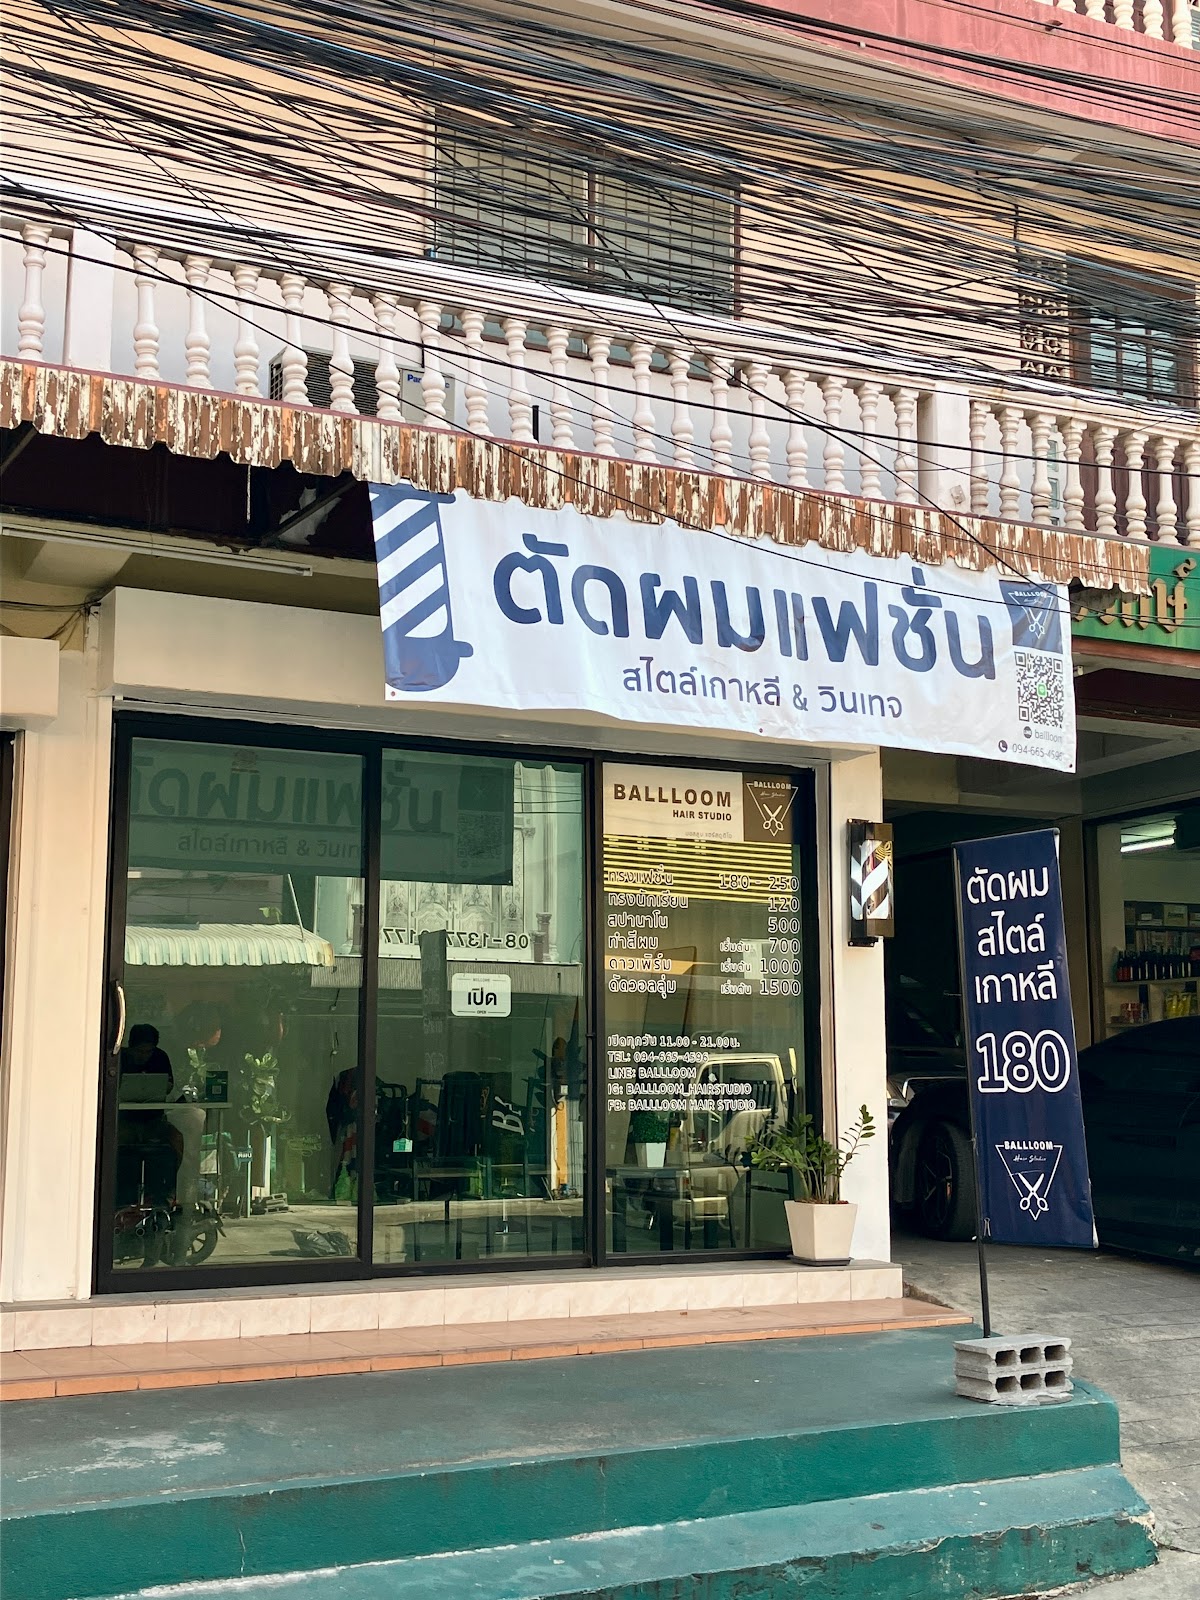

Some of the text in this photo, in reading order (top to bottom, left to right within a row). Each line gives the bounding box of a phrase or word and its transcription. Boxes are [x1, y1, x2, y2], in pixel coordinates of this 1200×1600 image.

[493, 532, 996, 680] ตัดผมแฟชั่น
[622, 656, 904, 719] สไตล์เกาหลี & วินเทจ
[613, 783, 731, 807] BALLLOOM
[753, 780, 792, 790] BALLLOOM
[672, 809, 732, 821] HAIR STUDIO
[607, 864, 674, 885] ทรงแฟชั่น
[719, 874, 751, 890] 180
[768, 876, 800, 892] 250
[967, 866, 1050, 904] ตัดผม
[608, 889, 800, 912] ทรงนักเรียน 120
[607, 910, 800, 933] สปานาโน 500
[608, 930, 800, 954] ทำสีผม เริ่มต้น 700
[977, 910, 1045, 957] สไตล์
[609, 953, 801, 975] ดาวเพิร์ม เริ่มต้น 1000
[609, 974, 801, 999] ดัดวอลลุ่ม เริ่มต้น 1500
[975, 958, 1058, 1003] เกาหลี
[468, 987, 497, 1006] เปิด
[607, 1033, 657, 1049] เปิดทุกวัน
[659, 1035, 690, 1047] 11.00
[607, 1051, 709, 1063] TEL: 094-665-4596
[975, 1029, 1072, 1093] 180
[608, 1067, 696, 1079] LINE: BALLLOOM
[608, 1083, 624, 1095] IG:
[608, 1099, 756, 1111] FB: BALLLOOM HAIR STUDIO
[1004, 1141, 1054, 1150] BALLLOOM
